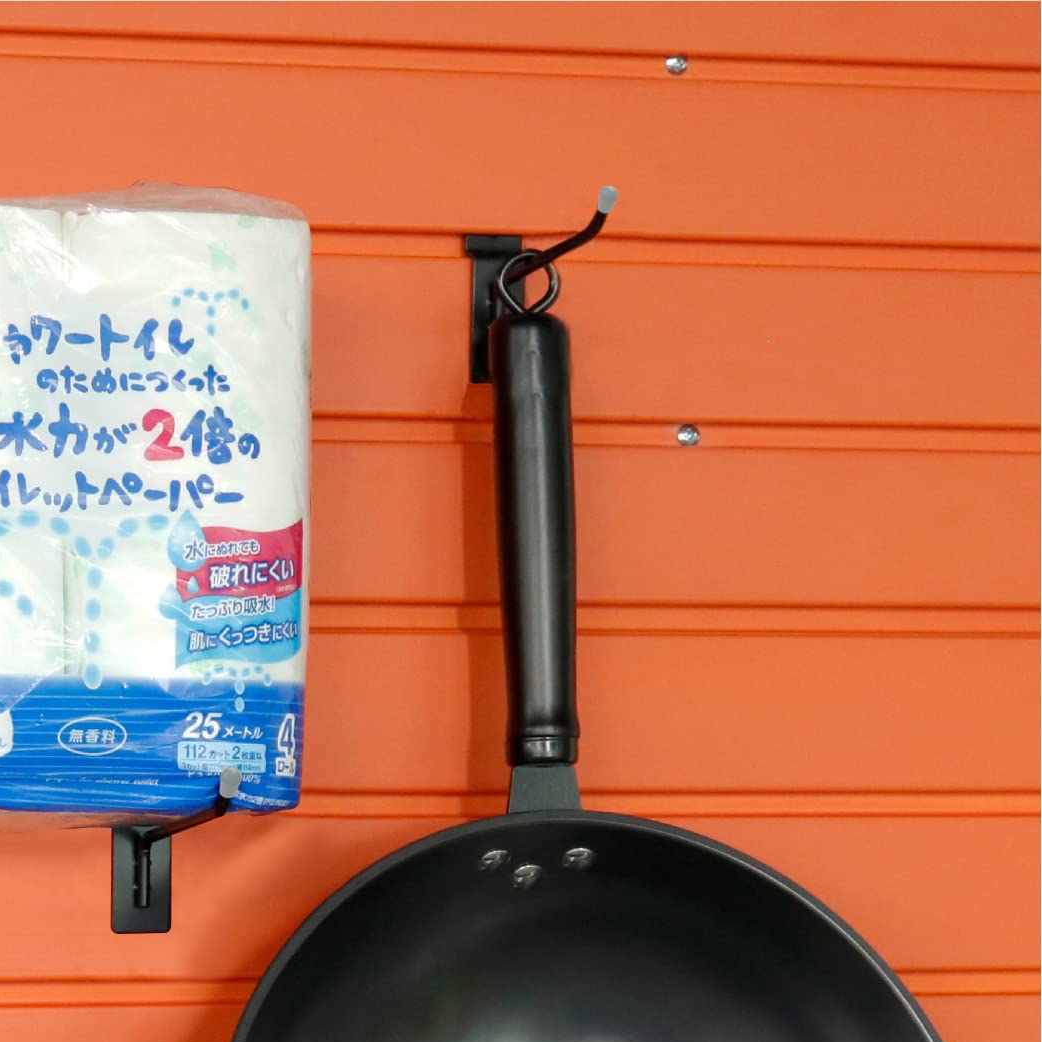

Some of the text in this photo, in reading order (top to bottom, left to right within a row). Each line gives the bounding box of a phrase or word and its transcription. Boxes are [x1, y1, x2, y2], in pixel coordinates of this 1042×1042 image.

[37, 364, 231, 395] のためにつくった
[210, 560, 295, 589] 破れにくい
[189, 621, 298, 650] 肌にくっつきにくい
[68, 729, 116, 744] 無香料
